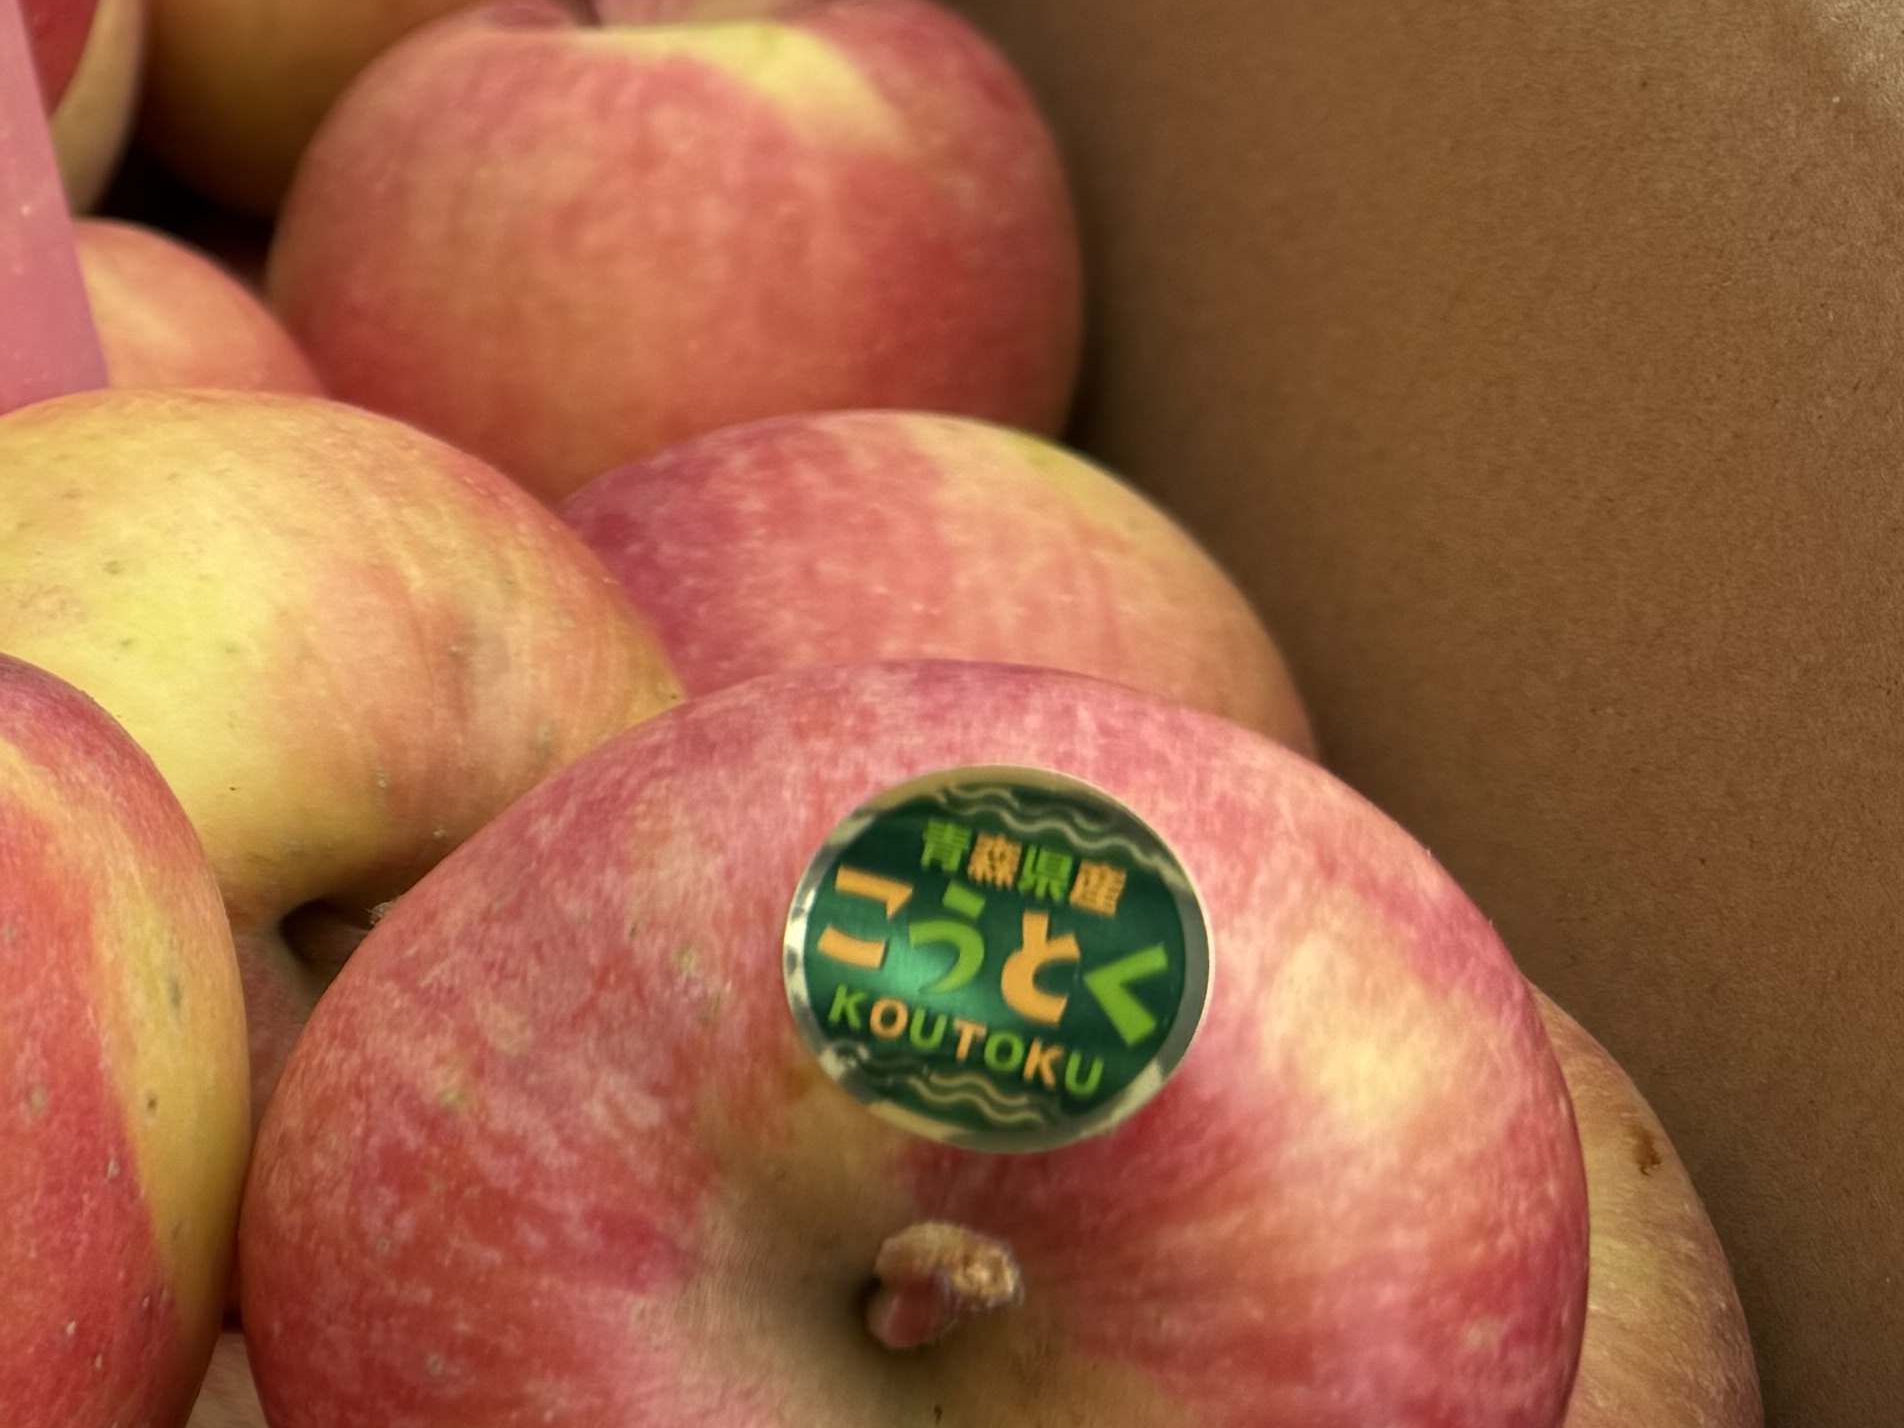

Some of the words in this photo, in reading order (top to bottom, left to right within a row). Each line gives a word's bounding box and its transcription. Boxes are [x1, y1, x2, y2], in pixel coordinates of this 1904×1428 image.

[817, 865, 1169, 1046] こうとく
[827, 984, 1105, 1095] KOUTOKU
